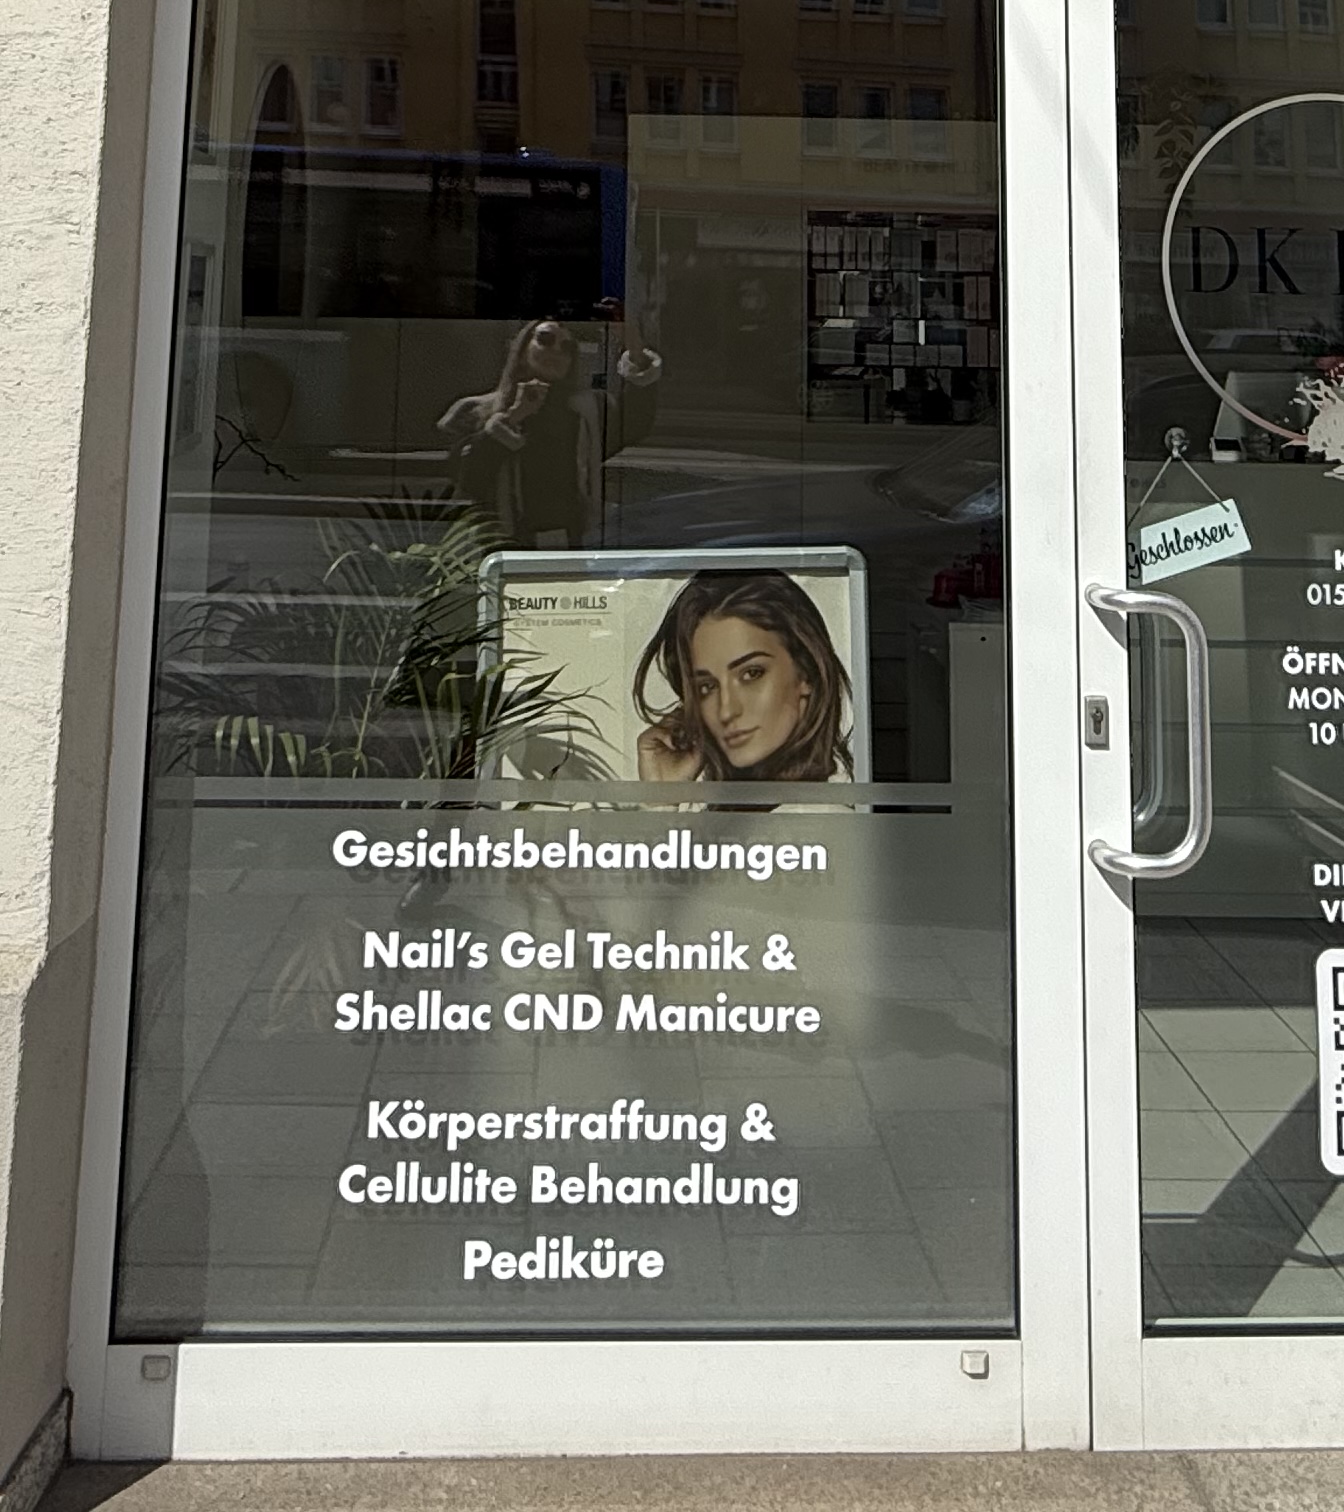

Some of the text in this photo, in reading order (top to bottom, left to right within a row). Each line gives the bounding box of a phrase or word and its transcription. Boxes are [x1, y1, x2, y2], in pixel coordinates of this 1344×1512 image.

[1184, 224, 1303, 296] DK
[1126, 521, 1236, 580] Geschlossen
[509, 596, 608, 611] BEAUTY HILLS
[1308, 722, 1337, 746] 10
[331, 828, 828, 880] Gesichtsbehandlungen
[500, 928, 575, 970] Gel
[586, 930, 751, 972] Technik
[761, 933, 798, 972] &
[334, 989, 822, 1035] Shellac CND Manicure
[366, 1098, 777, 1153] Körperstraffung &
[338, 1161, 800, 1217] Cellulite Behandlung
[462, 1236, 665, 1281] Pediküre
